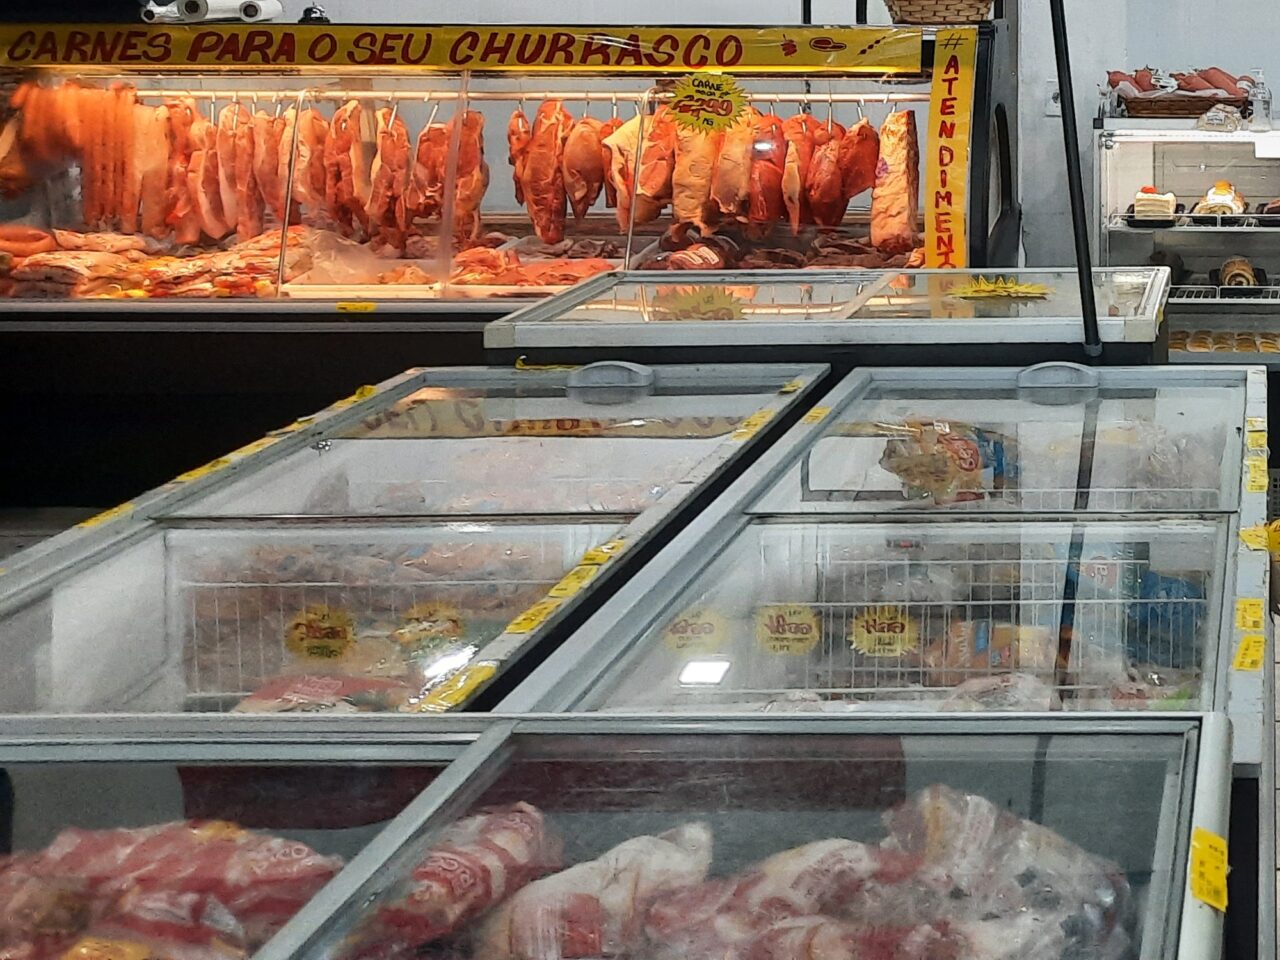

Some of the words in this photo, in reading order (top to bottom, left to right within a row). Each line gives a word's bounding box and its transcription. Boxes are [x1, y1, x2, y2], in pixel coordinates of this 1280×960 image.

[7, 30, 173, 63] CARNES
[186, 30, 296, 63] PARA
[307, 32, 338, 63] O
[347, 32, 432, 65] SEU
[450, 30, 743, 69] CHURRASCO
[692, 78, 724, 92] CARNE
